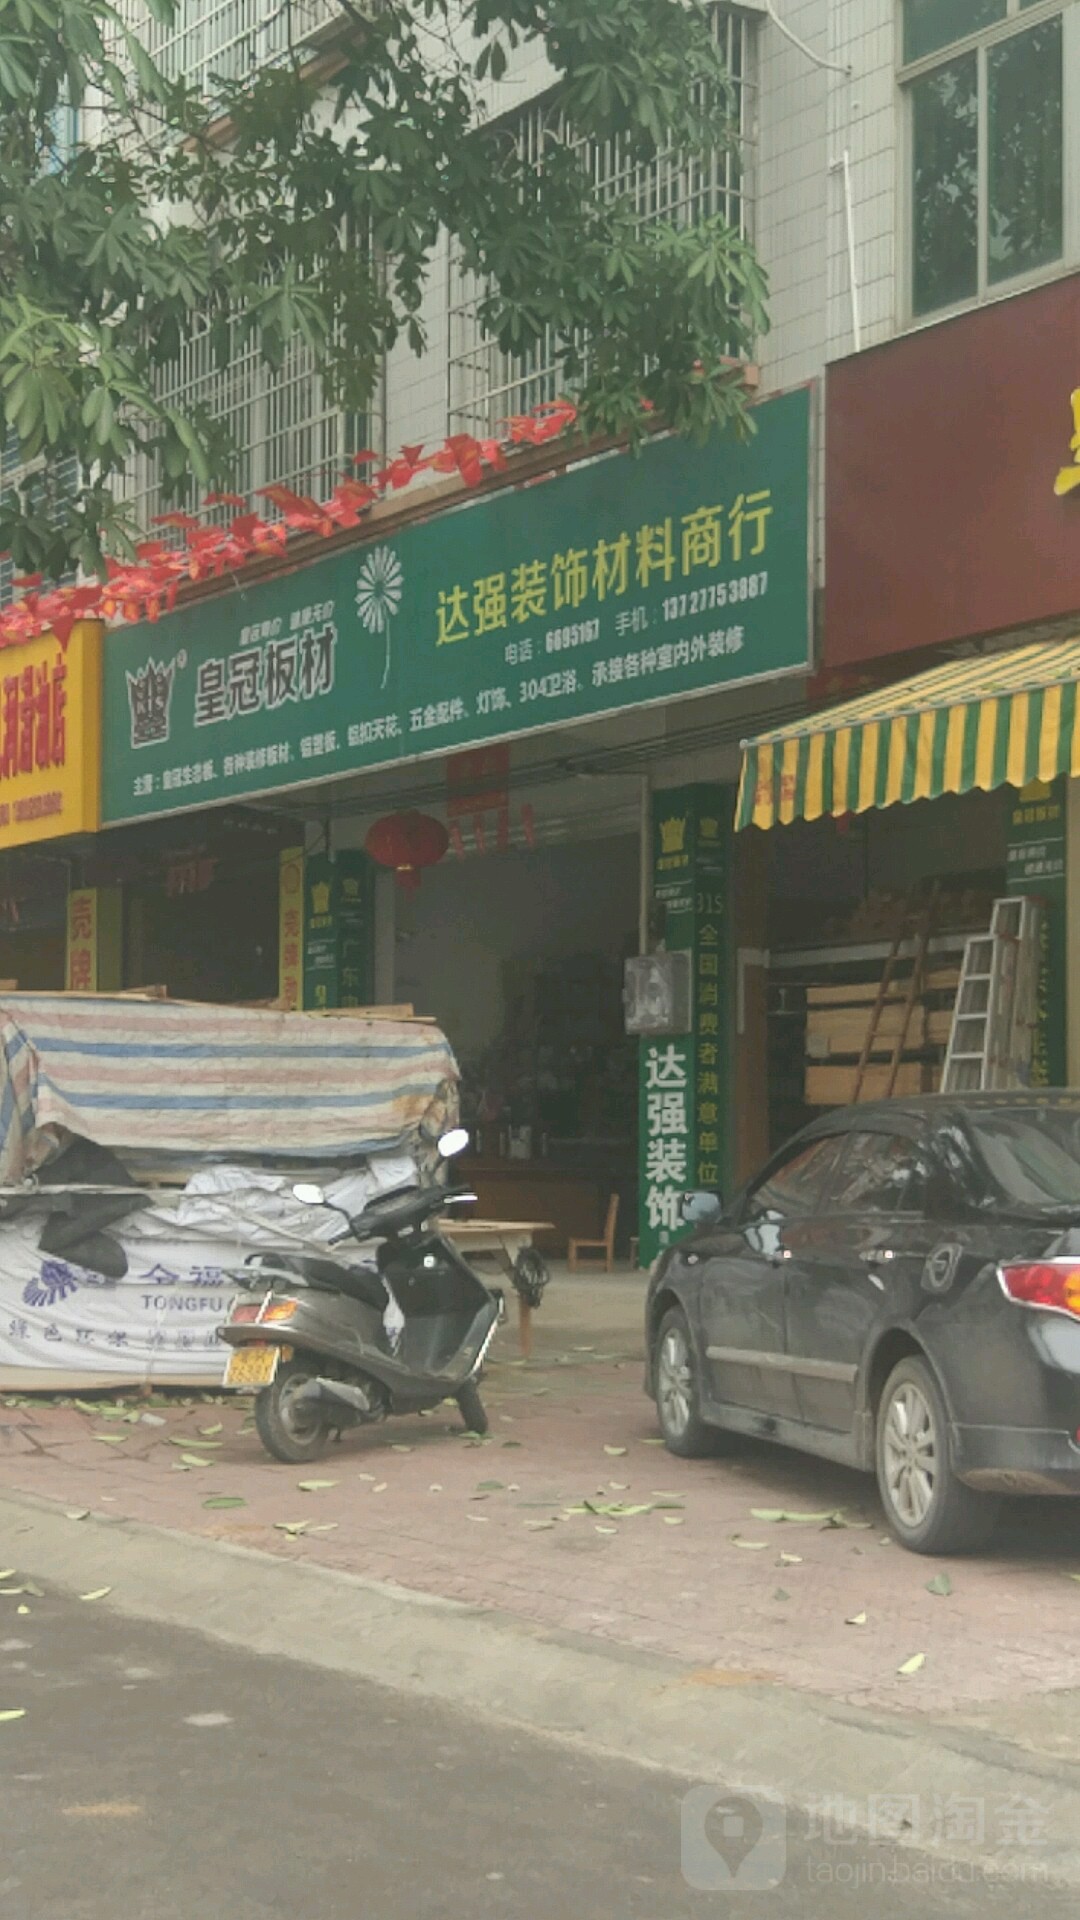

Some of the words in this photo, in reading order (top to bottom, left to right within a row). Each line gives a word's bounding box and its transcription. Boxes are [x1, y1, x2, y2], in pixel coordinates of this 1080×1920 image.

[436, 489, 773, 646] 达强装饰材料商行
[194, 621, 338, 728] 皇冠板材
[645, 1043, 688, 1231] 达强装饰
[141, 1295, 223, 1312] TONGFU
